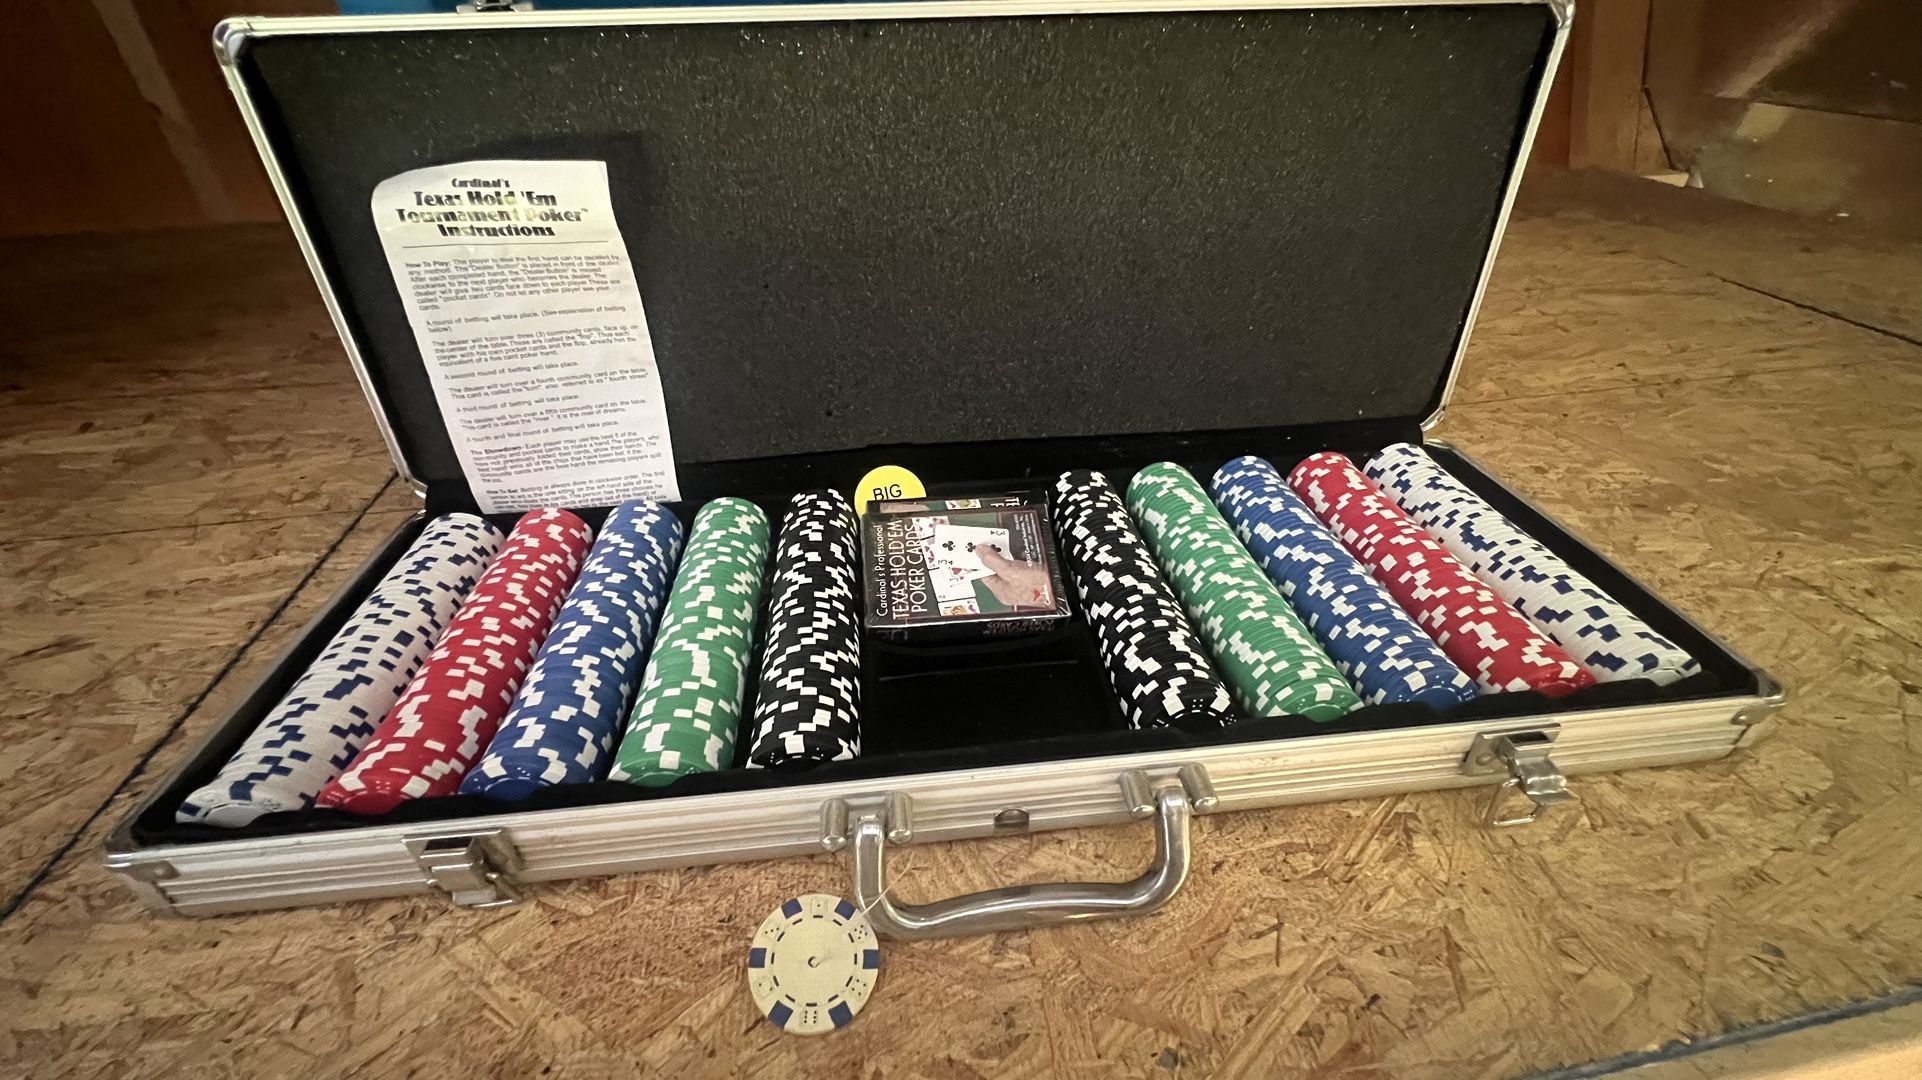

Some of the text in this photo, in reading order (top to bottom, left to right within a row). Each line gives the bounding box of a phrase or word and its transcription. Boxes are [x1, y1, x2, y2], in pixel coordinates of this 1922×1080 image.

[451, 178, 510, 188] Cardinal's
[413, 190, 558, 207] Texas Hold 'Em
[396, 208, 520, 223] Tournament
[437, 224, 556, 237] Instructions
[873, 484, 902, 500] BIG
[874, 525, 886, 571] Professional
[887, 519, 907, 576] HOLD'EM
[905, 524, 928, 613] POKER CARDS
[891, 579, 910, 620] TEXAS
